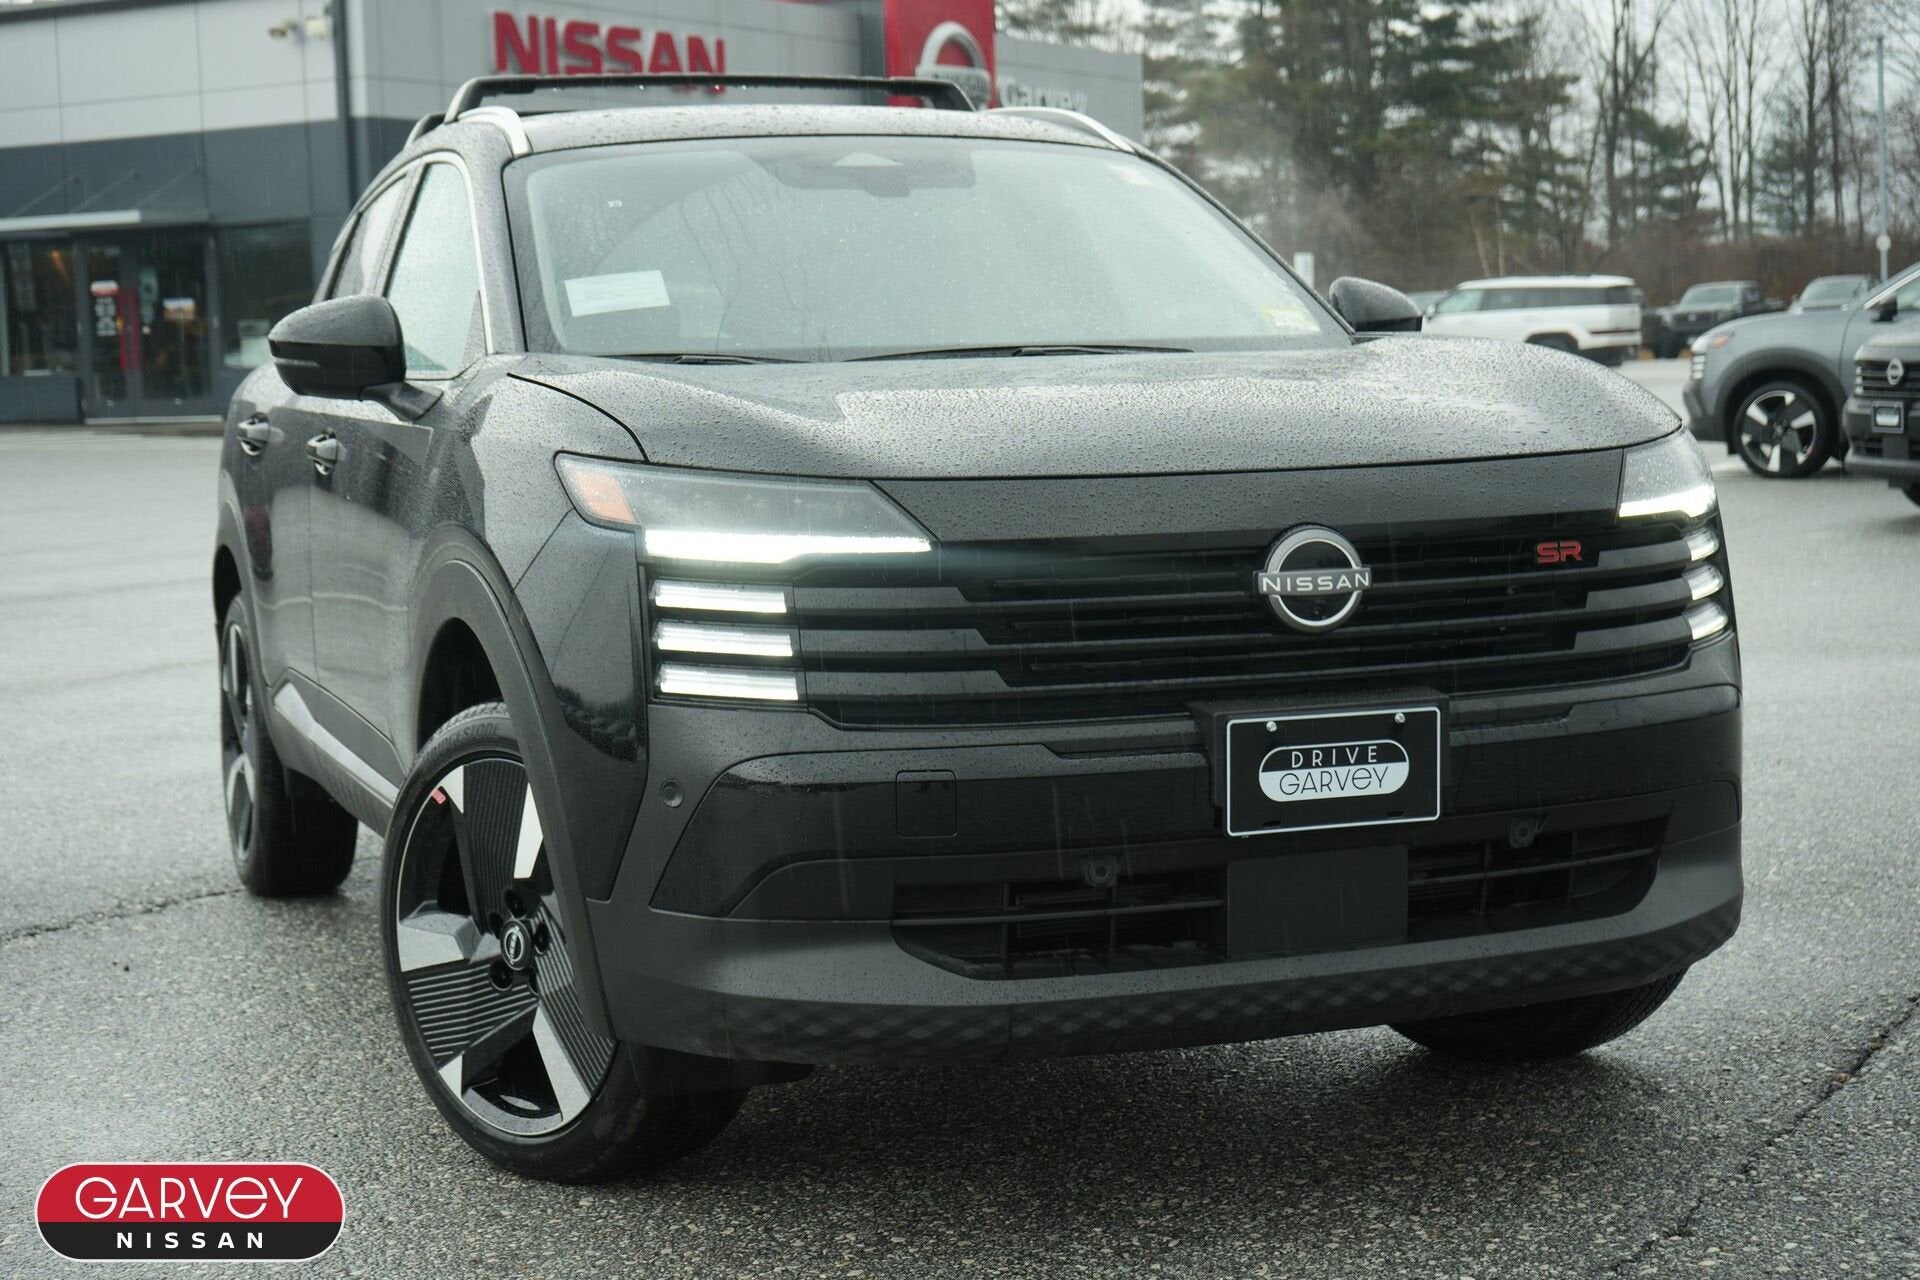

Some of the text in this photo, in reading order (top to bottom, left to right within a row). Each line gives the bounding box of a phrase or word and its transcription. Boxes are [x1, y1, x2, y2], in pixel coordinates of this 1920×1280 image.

[494, 11, 727, 93] NISSAN
[998, 75, 1088, 113] Garvey
[1536, 541, 1583, 564] SR
[1260, 571, 1370, 592] NISSAN
[1291, 745, 1378, 767] DRIVE
